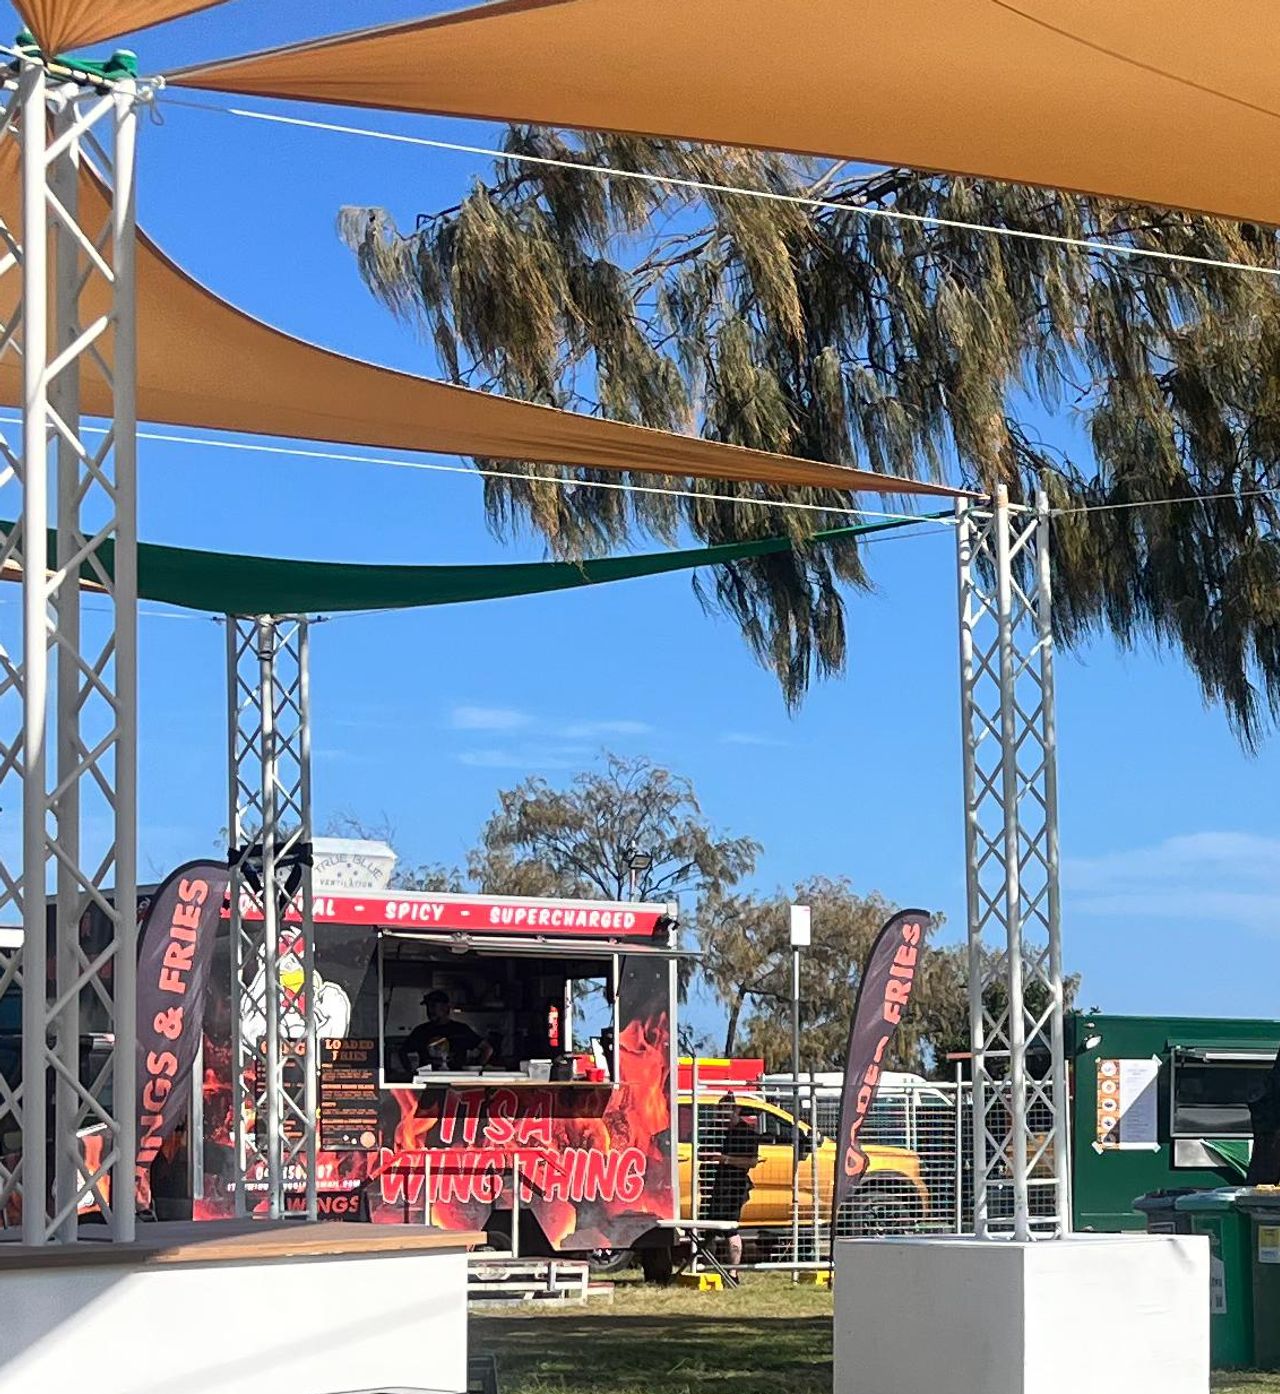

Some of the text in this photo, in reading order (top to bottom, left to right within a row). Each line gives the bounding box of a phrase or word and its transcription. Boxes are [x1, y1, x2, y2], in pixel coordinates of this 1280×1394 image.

[158, 877, 209, 994] FRIES
[384, 901, 444, 921] SPICY
[489, 905, 636, 929] SUPERCHARGED
[883, 922, 921, 1025] FRIES
[153, 1005, 184, 1040] &
[380, 1147, 647, 1204] WING THING
[286, 1195, 360, 1214] WNGS
